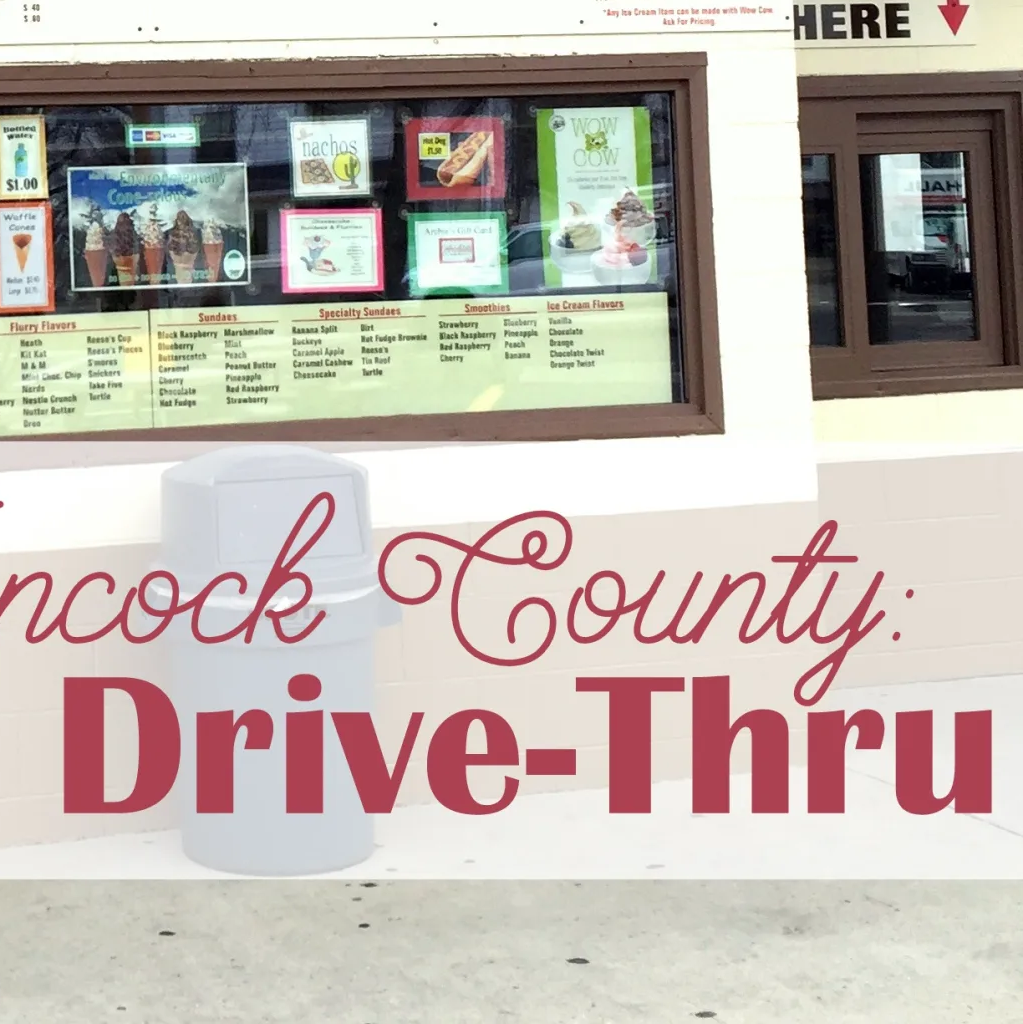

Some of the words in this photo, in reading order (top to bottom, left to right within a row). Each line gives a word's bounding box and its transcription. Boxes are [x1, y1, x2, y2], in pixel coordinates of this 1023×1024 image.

[794, 3, 911, 40] HERE
[570, 117, 619, 137] WOW
[303, 134, 357, 157] nachos
[574, 148, 621, 167] COW
[6, 178, 38, 191] $1.00
[465, 304, 511, 314] Smoothies
[547, 302, 561, 311] Ice
[561, 301, 591, 311] Cream
[593, 300, 624, 310] Flavors
[199, 312, 238, 323] Sundaes
[318, 308, 361, 320] Specialty
[364, 307, 402, 317] Sundaes
[10, 322, 39, 334] Flurry
[42, 321, 77, 331] Flavors
[224, 328, 274, 336] Marshmallow
[88, 370, 120, 378] Snickers
